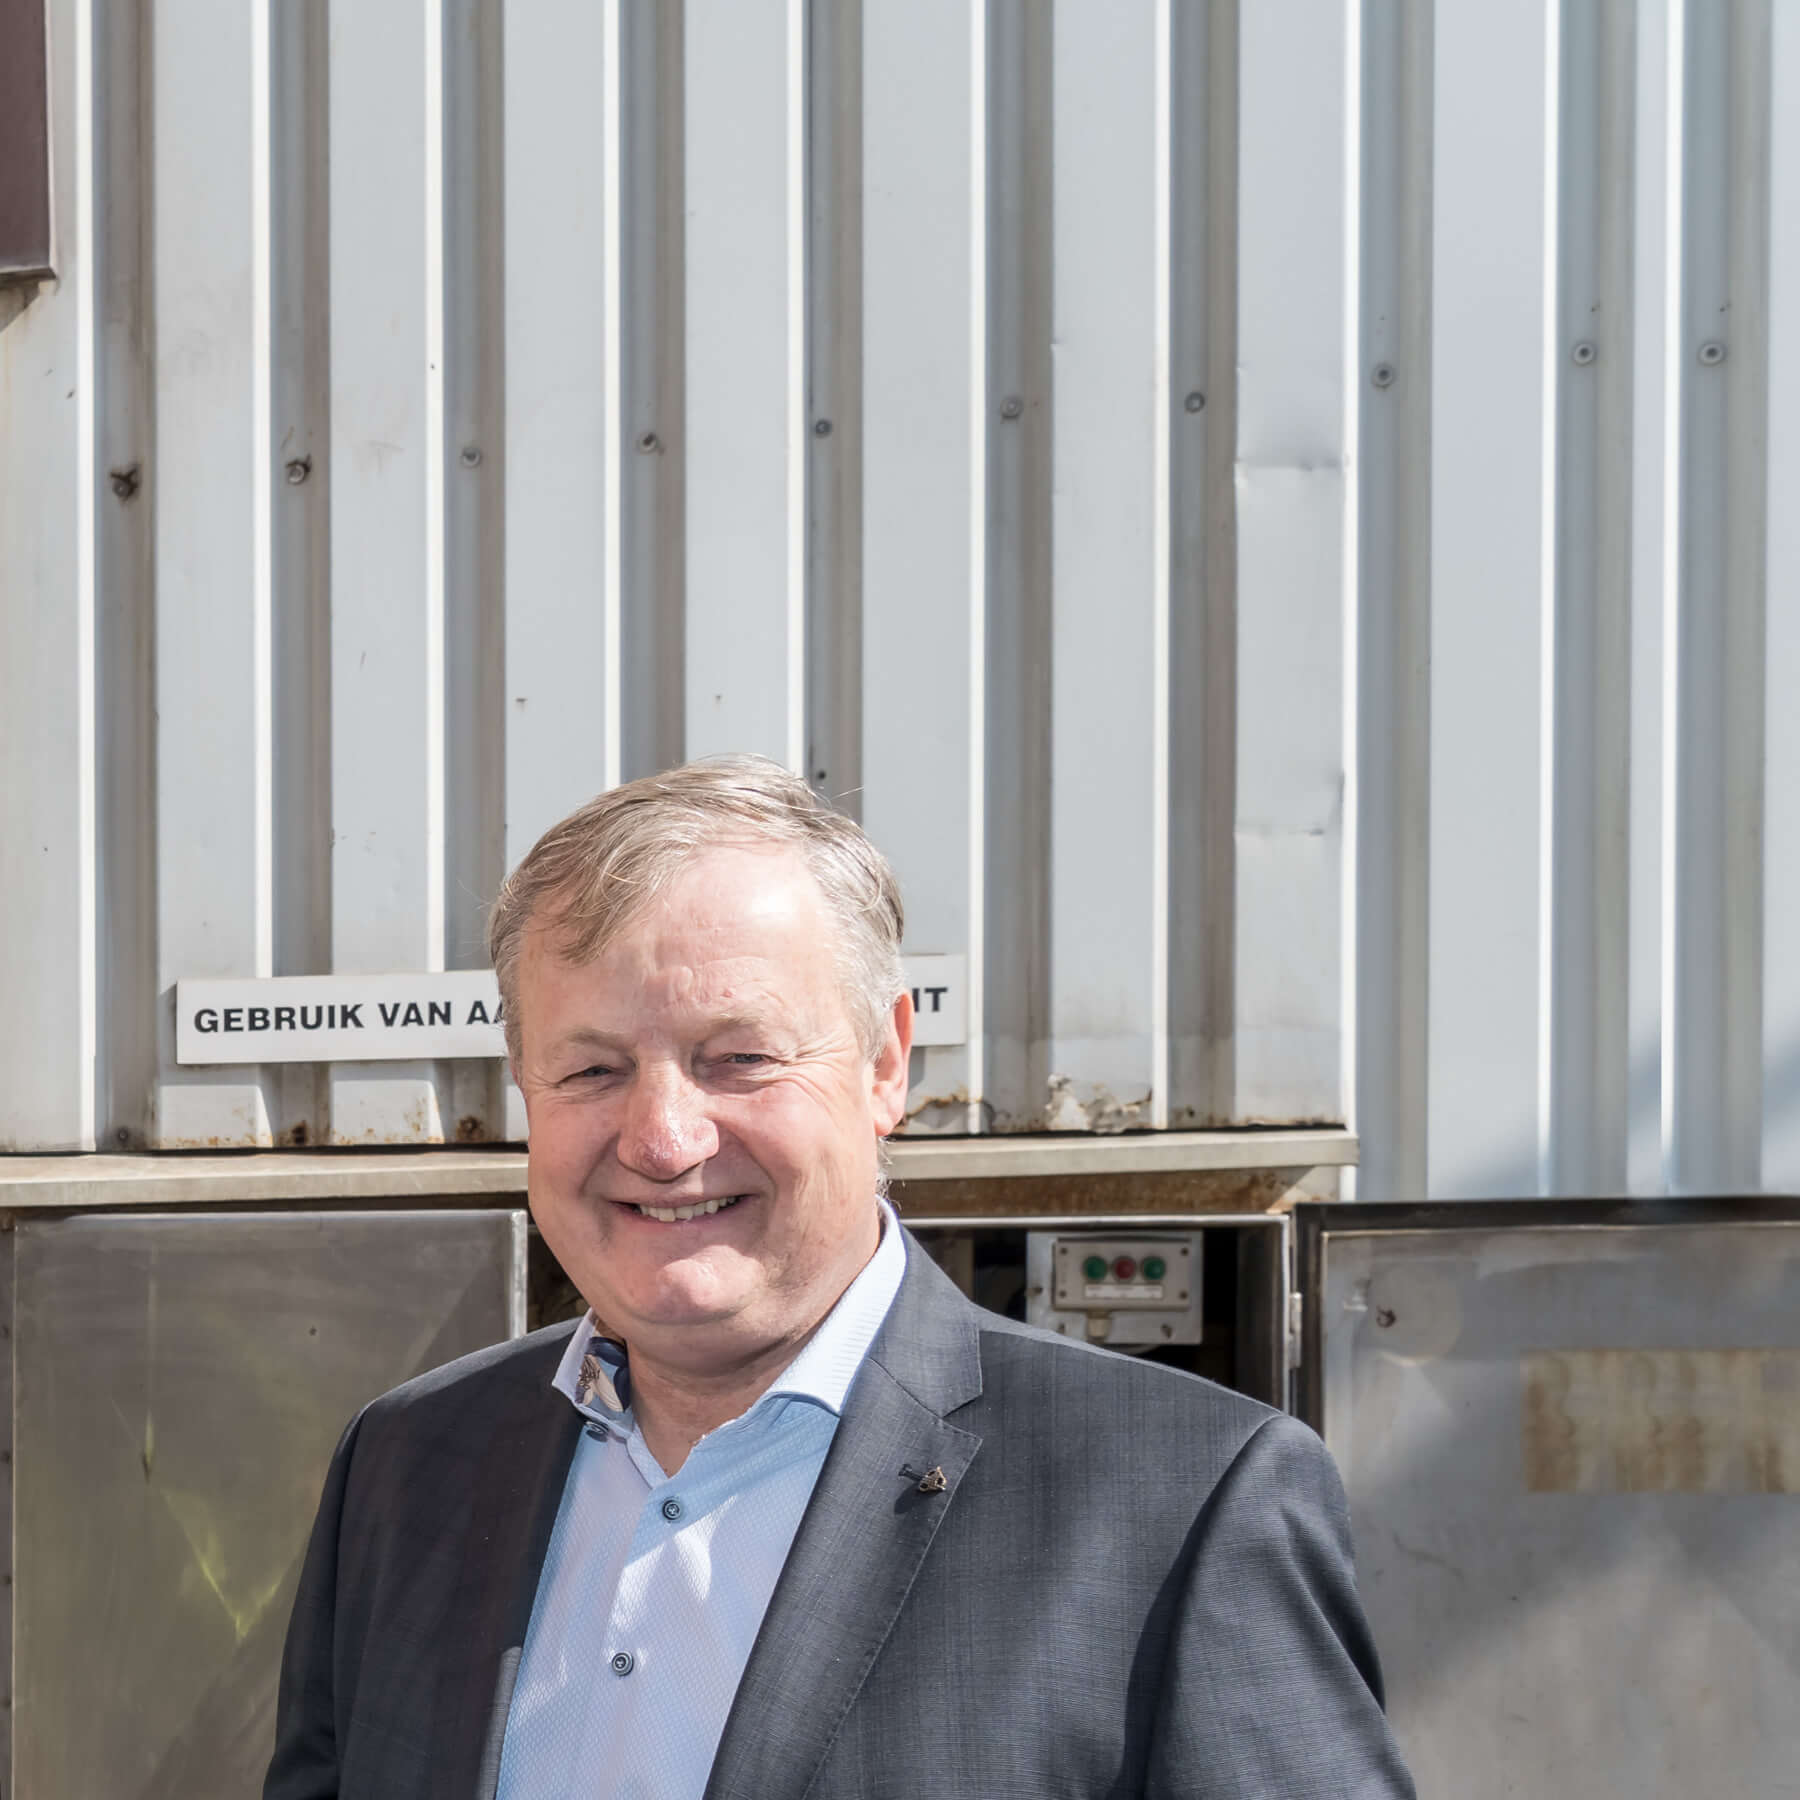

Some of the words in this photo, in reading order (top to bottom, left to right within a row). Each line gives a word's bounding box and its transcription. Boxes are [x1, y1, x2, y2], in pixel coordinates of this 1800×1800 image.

[193, 1003, 364, 1033] GEBRUIK
[378, 1001, 451, 1028] VAN
[466, 999, 504, 1026] A
